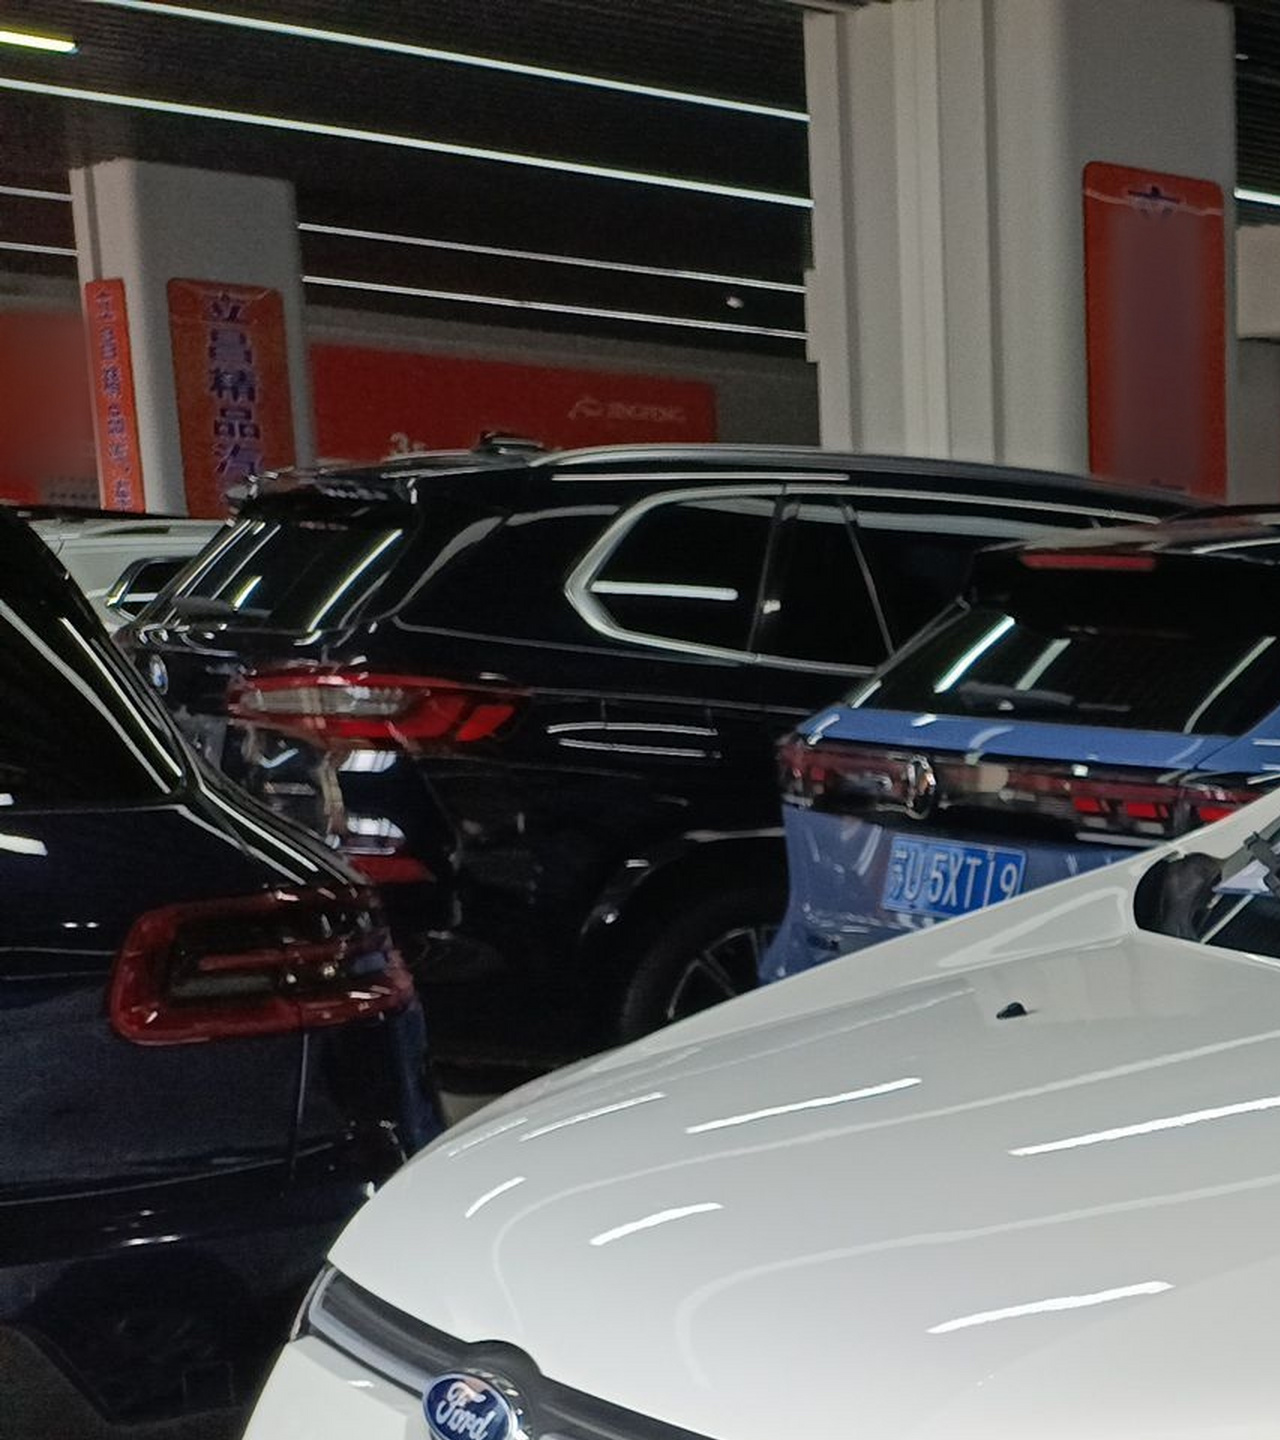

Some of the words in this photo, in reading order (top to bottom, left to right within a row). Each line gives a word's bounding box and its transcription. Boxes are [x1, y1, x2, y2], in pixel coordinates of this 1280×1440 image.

[208, 291, 261, 497] 立昌精品汽
